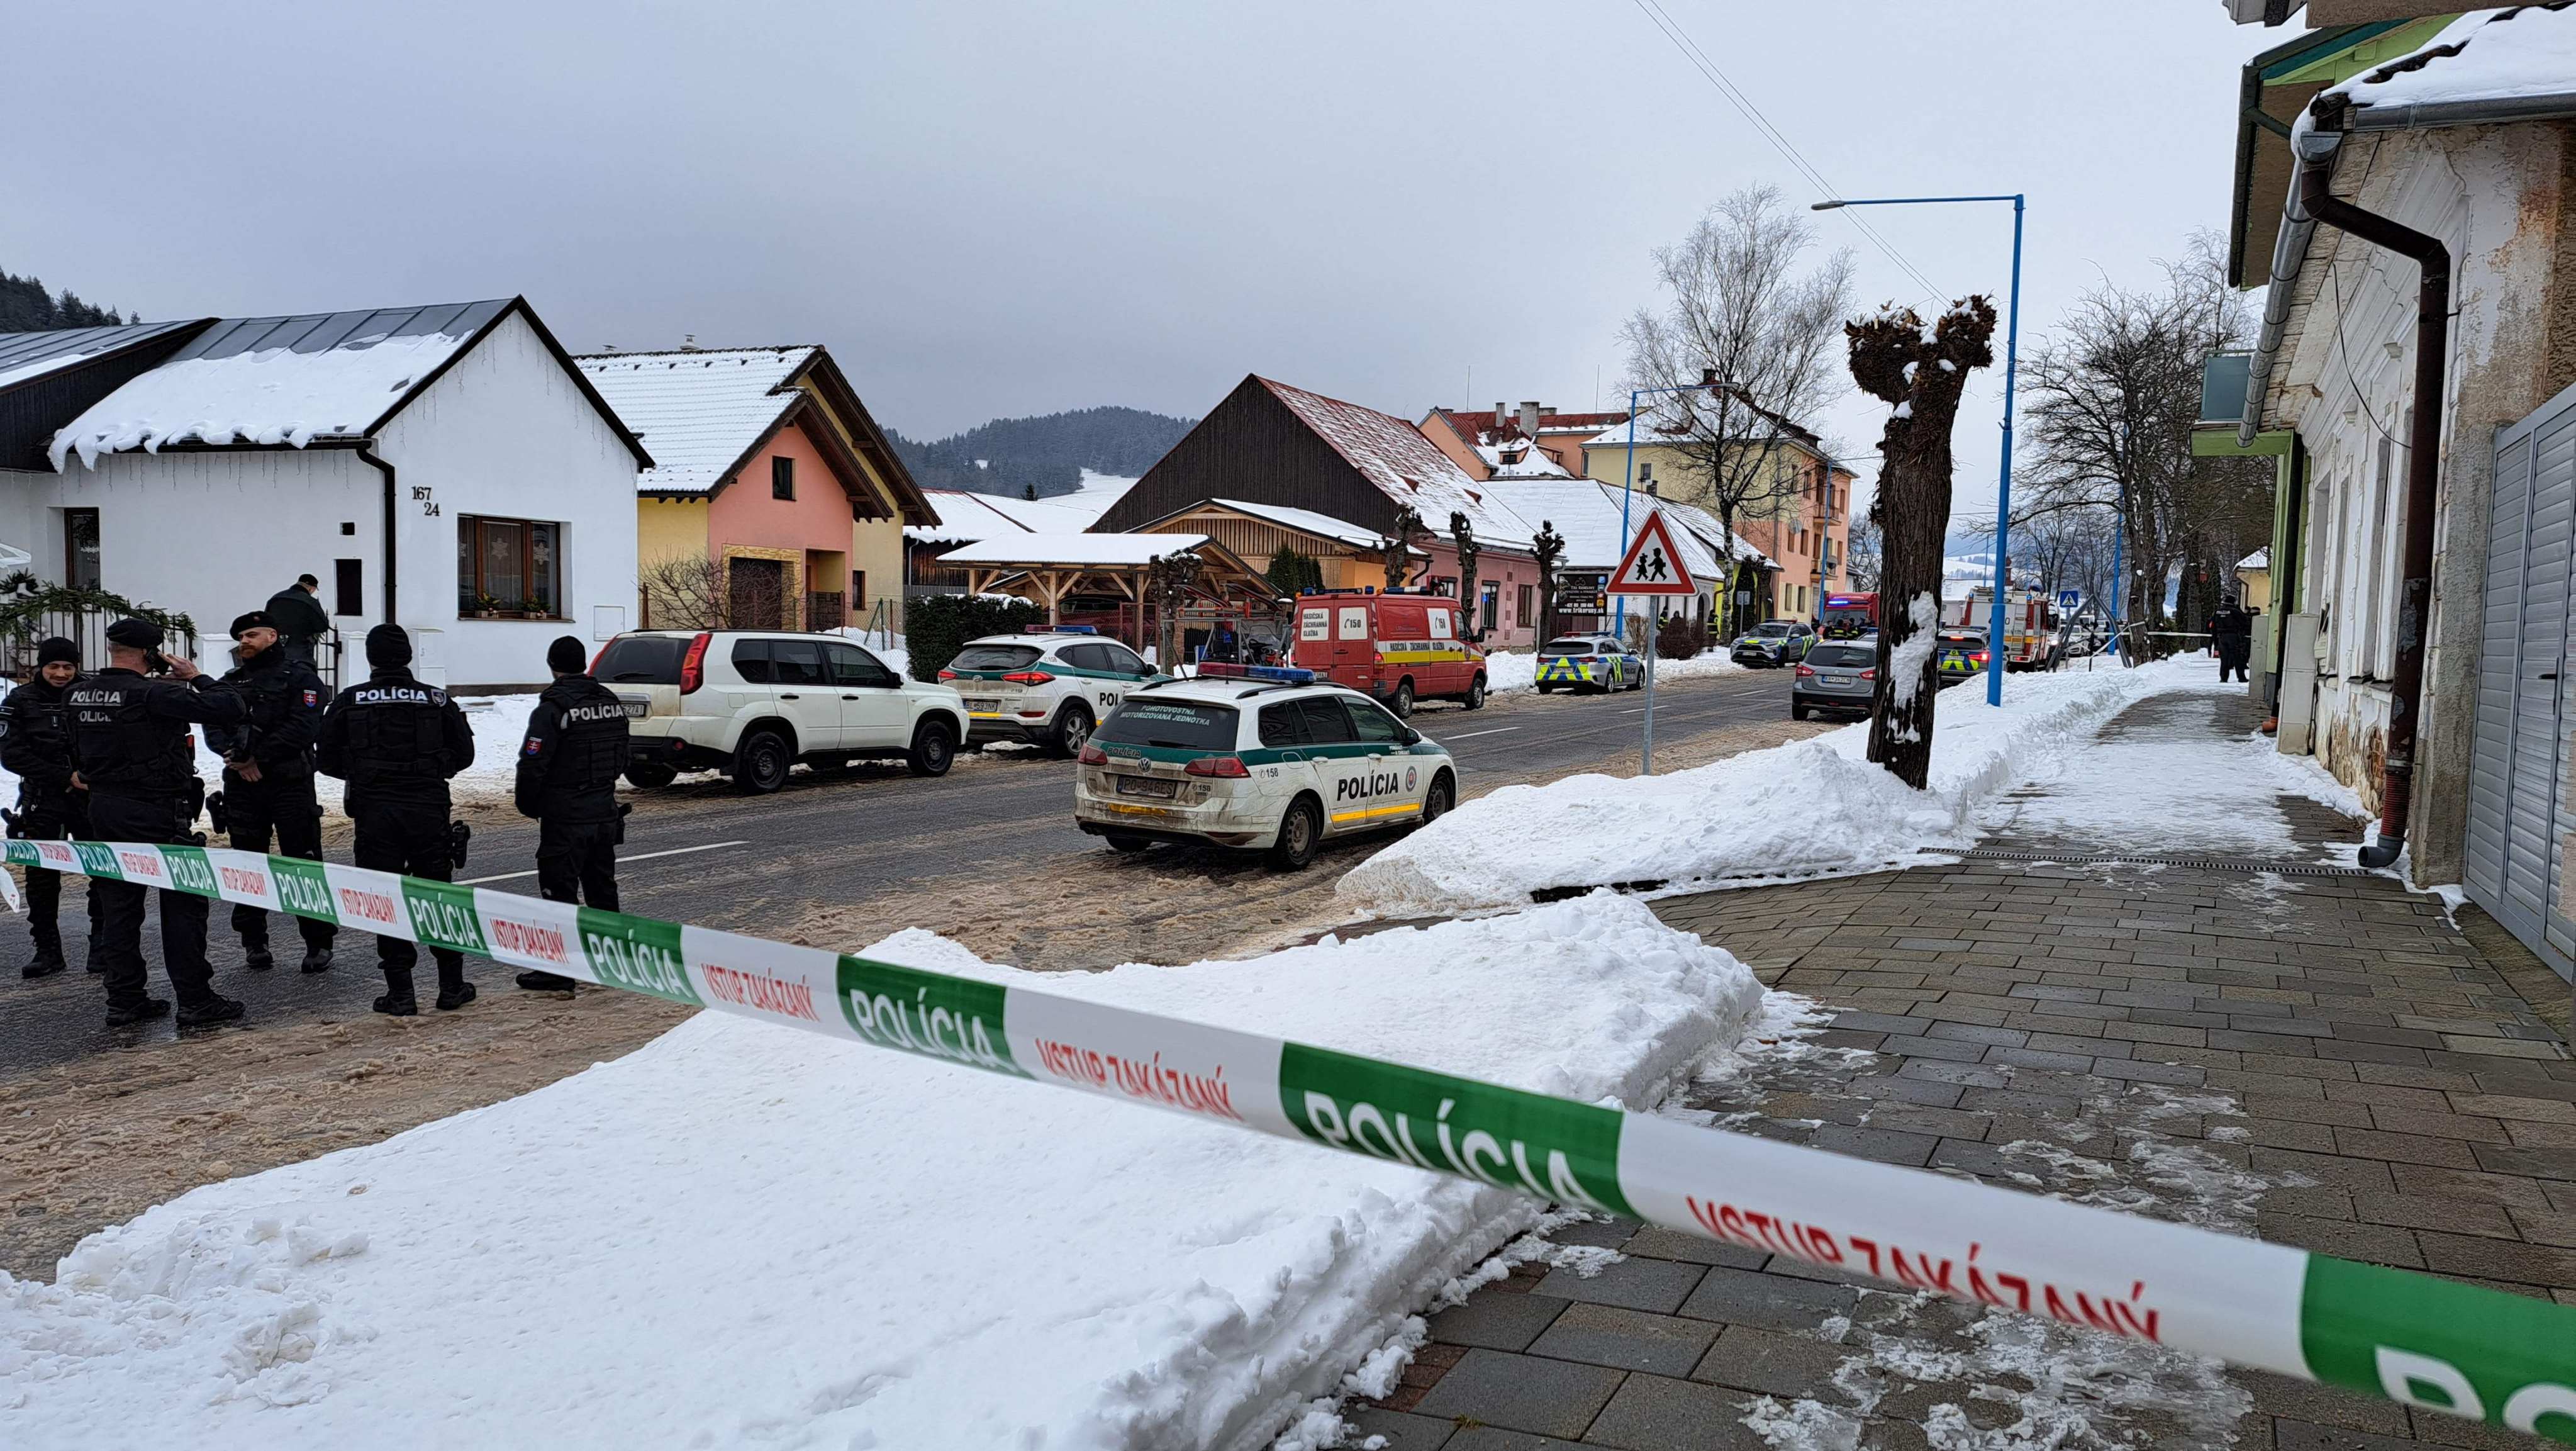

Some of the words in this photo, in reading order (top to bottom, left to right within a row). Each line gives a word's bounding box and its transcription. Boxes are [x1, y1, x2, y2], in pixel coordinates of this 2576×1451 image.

[411, 485, 432, 500] 167
[423, 501, 440, 516] 24
[1350, 619, 1361, 629] 150
[70, 688, 121, 703] POLÍCIA
[355, 686, 428, 702] POLÍCIA
[1141, 705, 1196, 715] POHOTOVOSTNÁ
[569, 703, 625, 722] POLÍCIA
[1120, 712, 1172, 720] MOTORIZOVANÁ
[1172, 715, 1210, 726] JEDNOTKA
[1107, 746, 1141, 758] POLÍCIA
[1266, 767, 1279, 778] 158
[1337, 770, 1398, 802] POLÍCIA
[75, 841, 121, 875] POLÍCIA
[166, 851, 216, 892] POLÍCIA
[276, 868, 334, 916] POLÍCIA
[409, 892, 484, 950] POLÍCIA
[489, 917, 520, 953] VSTUP
[586, 928, 693, 999] POLÍCIA
[701, 963, 747, 1006] VSTUP
[741, 966, 820, 1022] ZAKÁZANÝ
[849, 986, 1018, 1071] POLÍCIA
[1034, 1037, 1107, 1089] VSTUP
[1105, 1050, 1246, 1123] ZAKÁZANÝ
[1303, 1098, 1617, 1214] POLÍCIA
[1685, 1195, 1844, 1264] VSTUP
[1849, 1236, 2163, 1344] ZAKÁZANÝ
